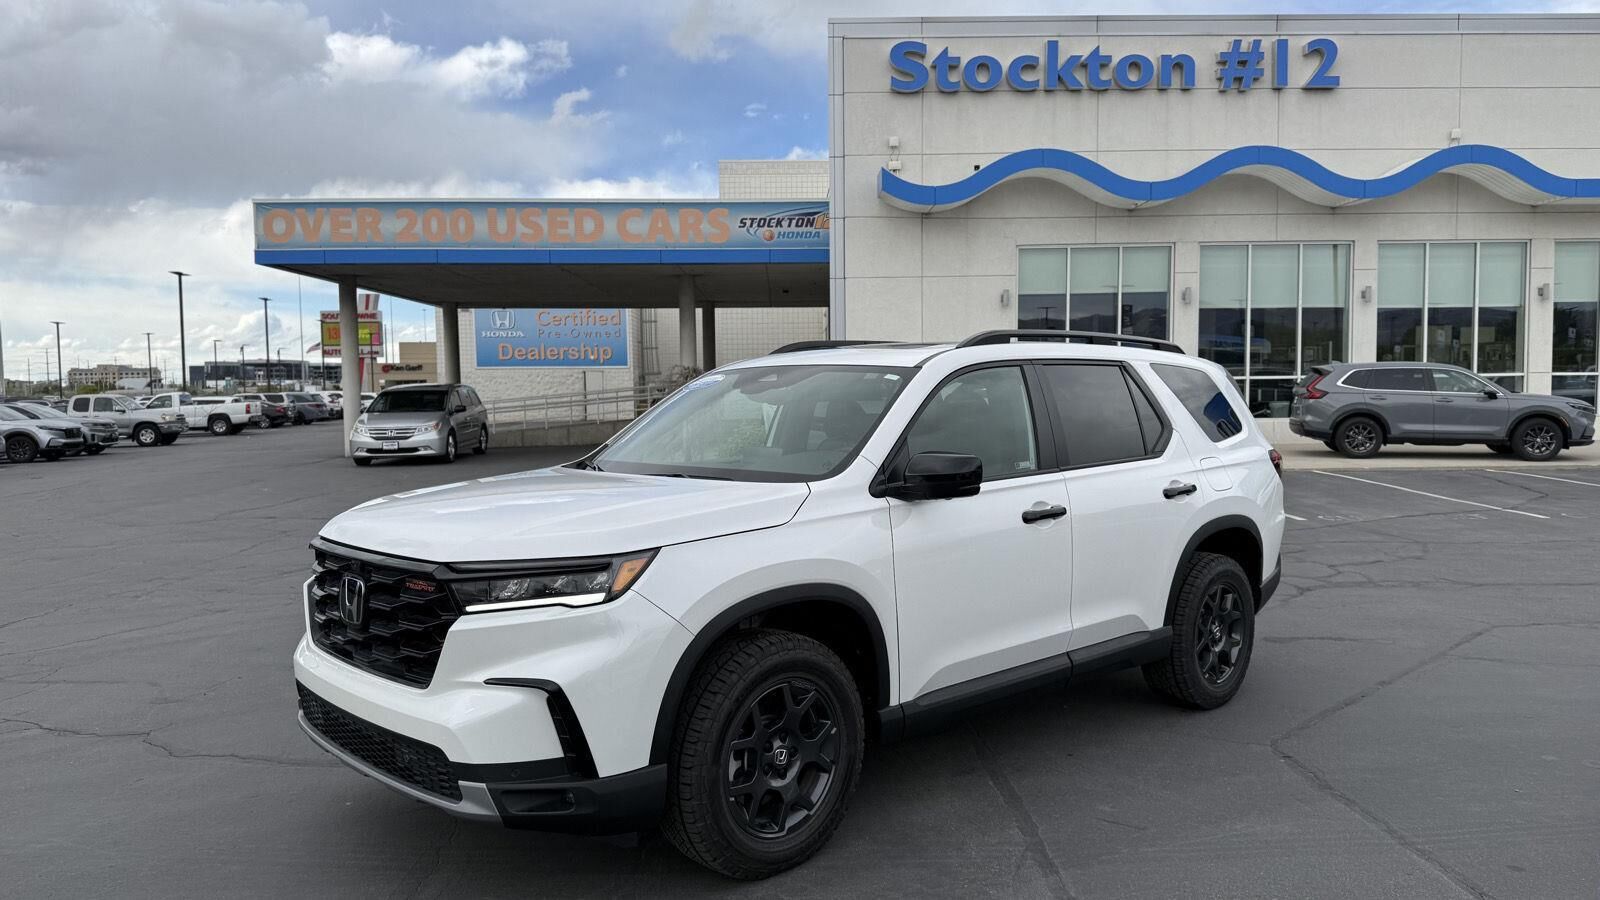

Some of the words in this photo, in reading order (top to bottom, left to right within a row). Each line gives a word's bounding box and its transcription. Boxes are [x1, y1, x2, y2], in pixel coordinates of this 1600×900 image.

[889, 40, 1196, 93] Stockton
[1216, 38, 1341, 92] #12
[262, 207, 385, 243] OVER
[395, 207, 476, 243] 200
[487, 207, 605, 244] USED
[616, 207, 731, 244] CARS
[738, 217, 816, 228] STOCKTON
[777, 231, 821, 239] HONDA
[537, 309, 622, 326] Certified
[538, 328, 622, 338] Pre-Owned
[498, 343, 613, 363] Dealership
